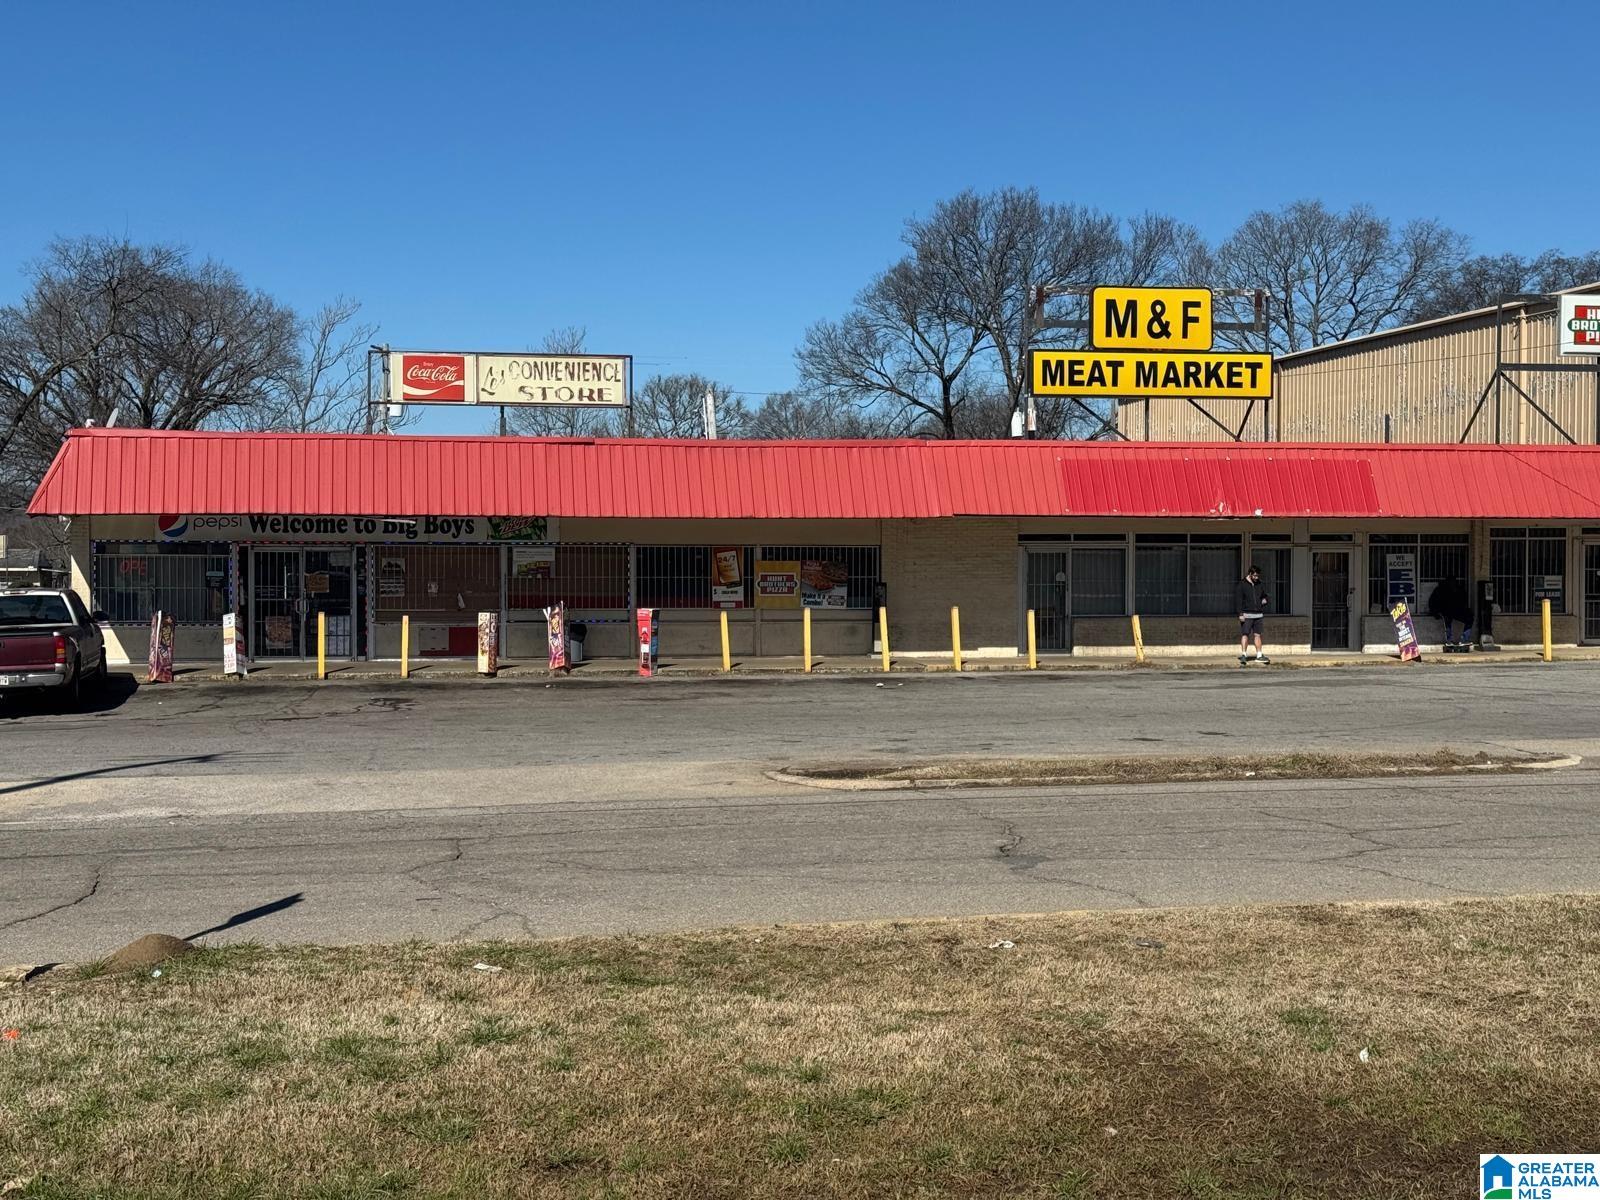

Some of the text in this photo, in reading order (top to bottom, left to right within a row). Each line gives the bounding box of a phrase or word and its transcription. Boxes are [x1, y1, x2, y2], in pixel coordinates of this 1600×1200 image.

[1105, 299, 1202, 340] M & F
[1587, 309, 1600, 319] H
[1572, 320, 1600, 330] BRO
[407, 364, 459, 381] Coca-Cola
[508, 360, 621, 382] CONVENIENCE
[1041, 359, 1264, 388] MEAT MARKET
[518, 385, 613, 401] STORE
[193, 515, 475, 539] pepsi Welcome to Big Boys
